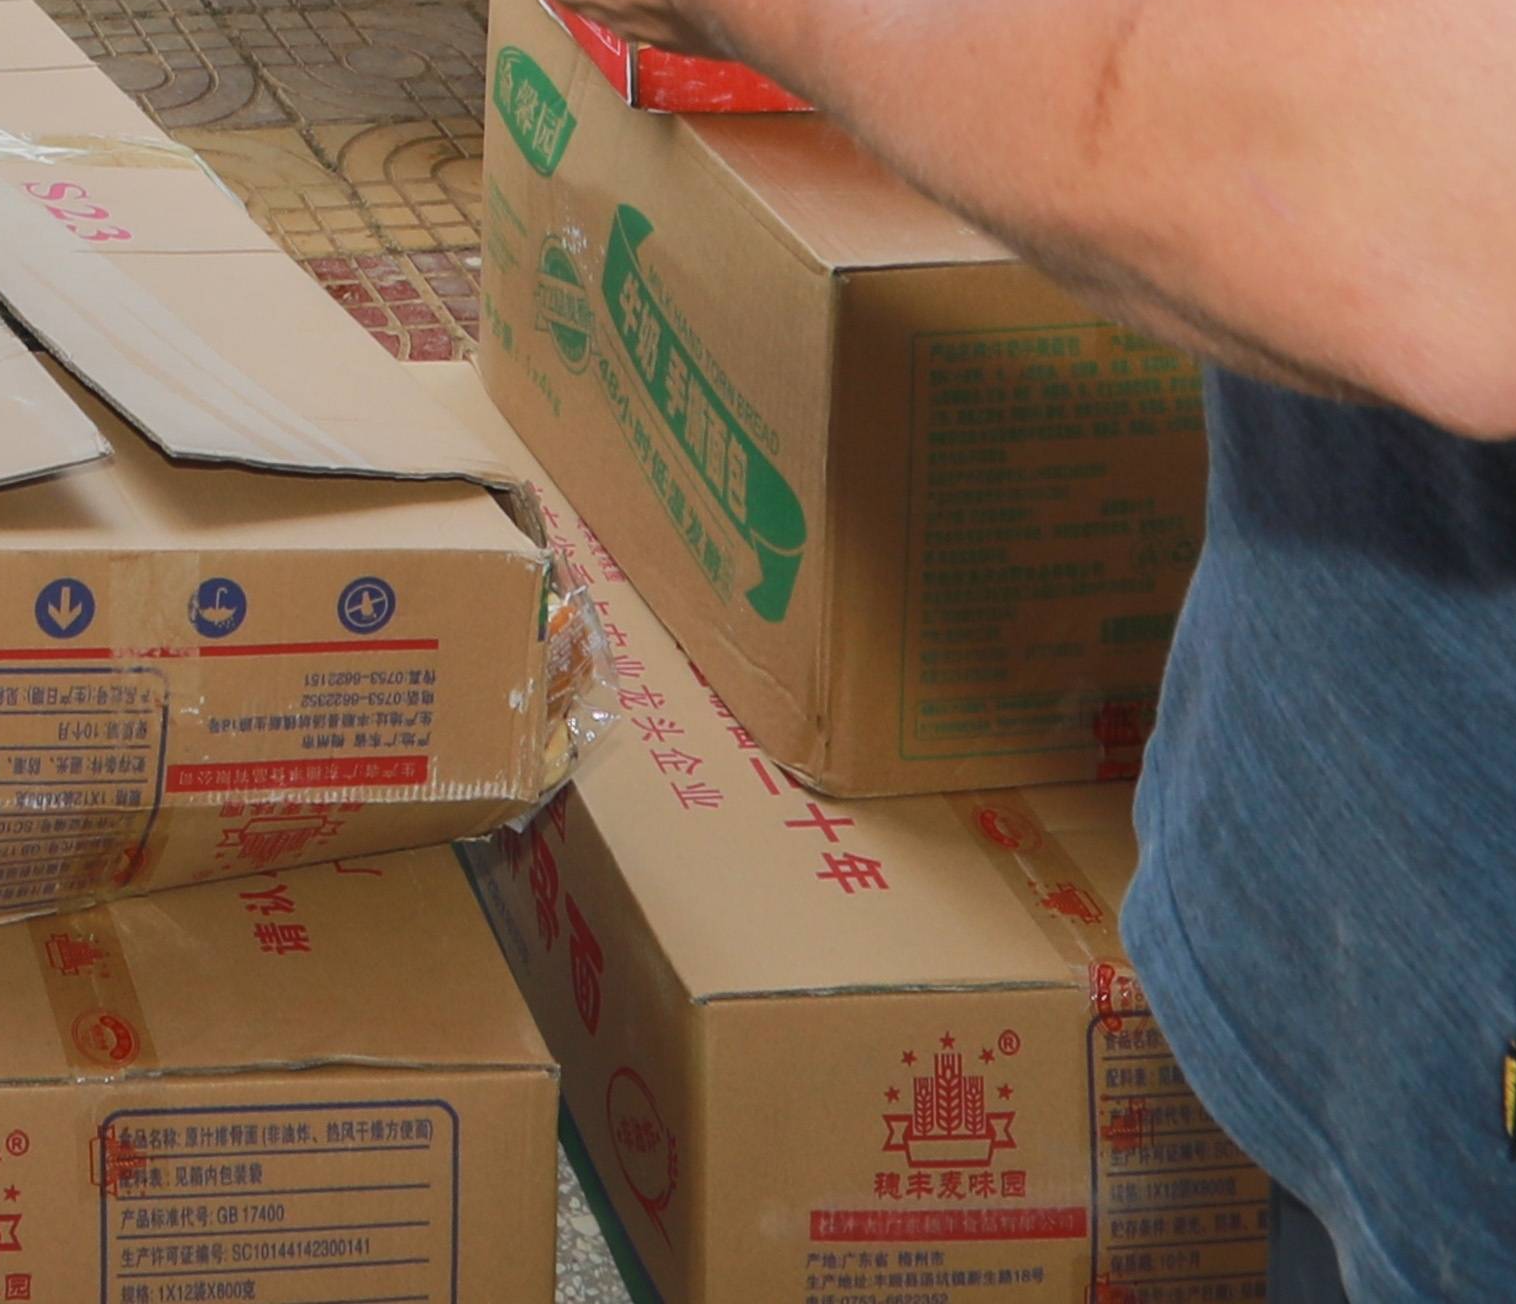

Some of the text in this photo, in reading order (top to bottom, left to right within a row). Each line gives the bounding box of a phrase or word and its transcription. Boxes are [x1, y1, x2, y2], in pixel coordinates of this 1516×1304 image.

[21, 180, 132, 245] S23
[619, 274, 661, 384] 牛奶
[873, 1170, 1028, 1200] 穗丰麦味园
[120, 1205, 285, 1230] 产品标准代号: GB 17400
